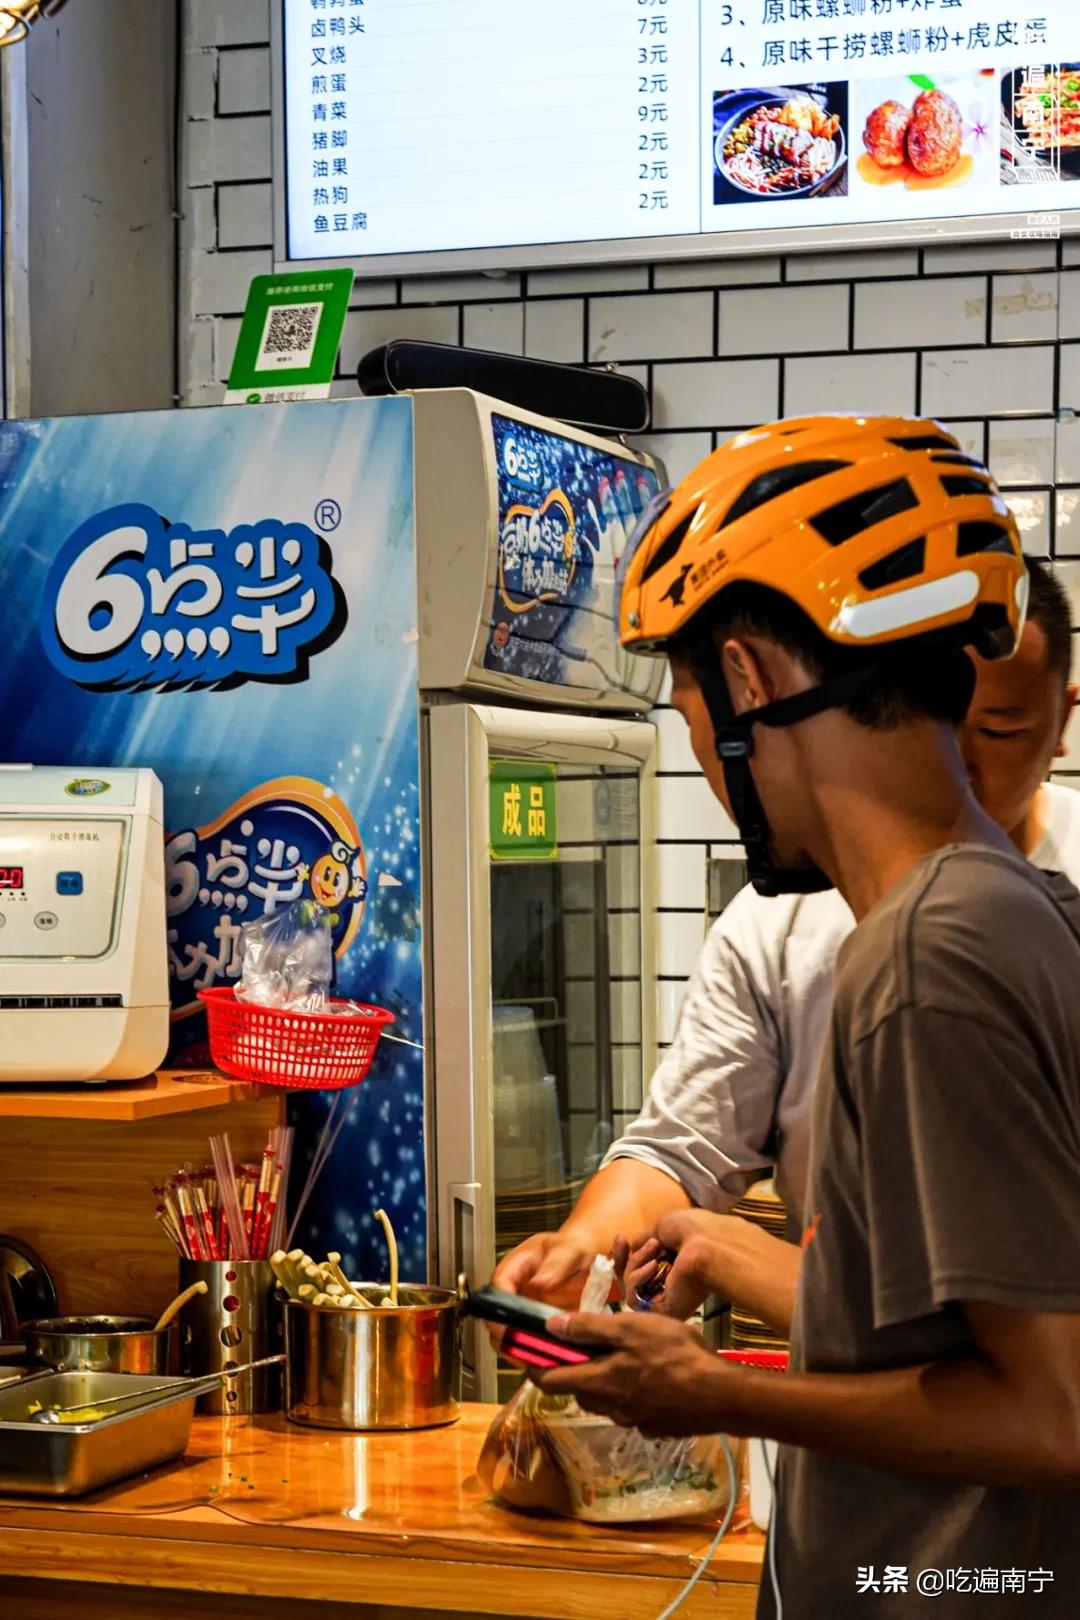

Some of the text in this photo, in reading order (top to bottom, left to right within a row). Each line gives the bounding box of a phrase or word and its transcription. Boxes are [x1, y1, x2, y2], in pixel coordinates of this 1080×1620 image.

[311, 15, 365, 37] 卤鸭头
[637, 15, 668, 35] 7元
[311, 46, 347, 66] 叉烧
[637, 44, 668, 64] 3元
[311, 73, 347, 94] 煎蛋
[638, 72, 668, 93] 2元
[312, 101, 348, 121] 青菜
[638, 102, 669, 122] 9元
[638, 131, 669, 152] 2元
[312, 158, 348, 178] 油果
[638, 160, 669, 181] 2元
[313, 186, 348, 206] 热狗
[638, 189, 669, 210] 2元
[313, 211, 368, 234] 鱼豆腐
[502, 783, 546, 837] 成品
